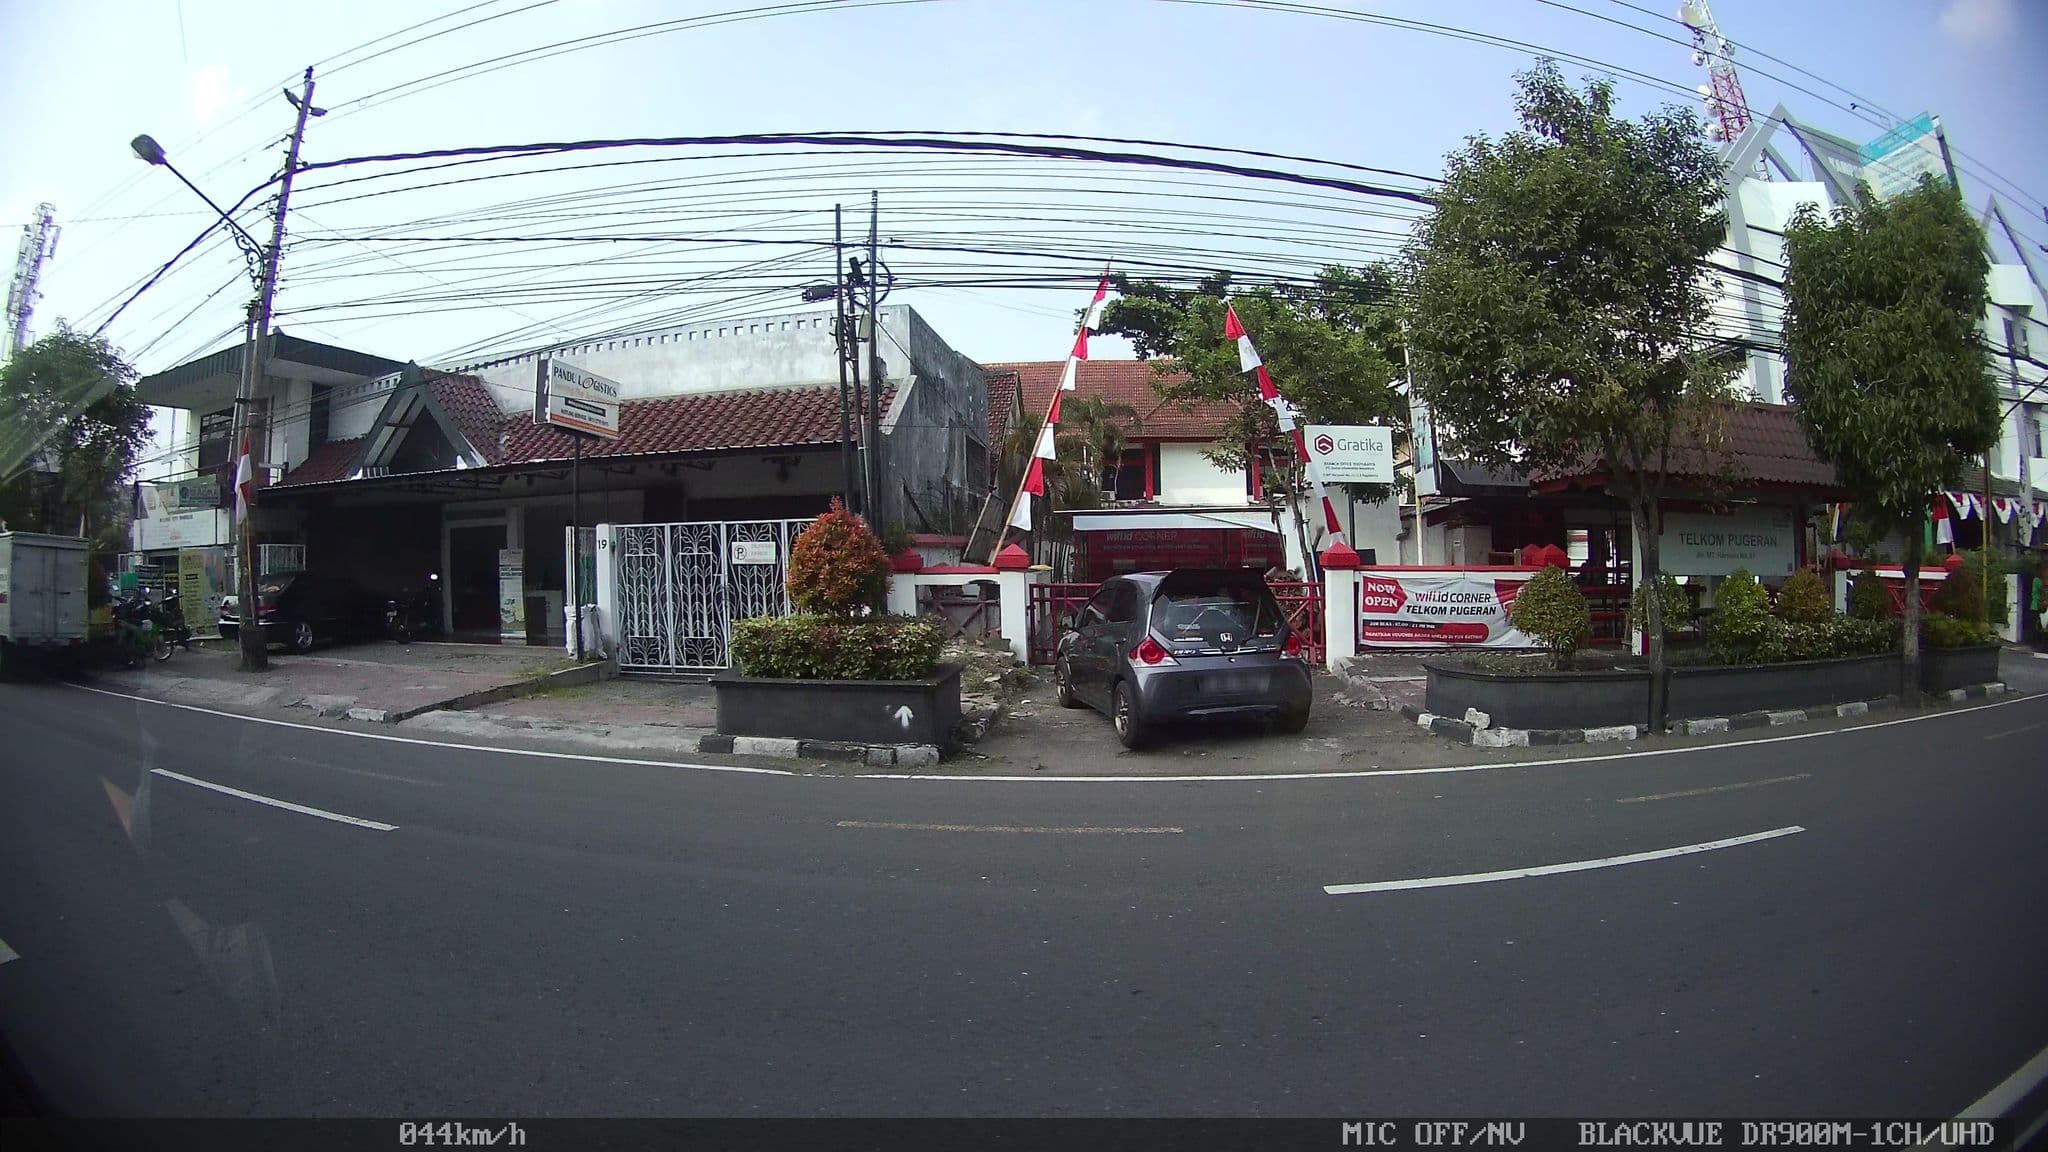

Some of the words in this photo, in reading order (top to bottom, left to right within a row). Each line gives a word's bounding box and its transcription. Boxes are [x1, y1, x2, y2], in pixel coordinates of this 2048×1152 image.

[554, 366, 576, 384] PANDU
[577, 375, 618, 398] LOGISTICS
[1338, 438, 1384, 452] Gratika
[598, 539, 608, 550] 19
[1679, 532, 1725, 547] TELKOM
[1727, 533, 1777, 548] PUGERAN
[1367, 582, 1397, 595] NOW
[1365, 595, 1398, 608] OPEN
[1415, 590, 1449, 603] wifi.id
[1449, 592, 1492, 603] CORNER
[1406, 604, 1448, 616] TELKOM
[1449, 605, 1497, 616] PUGERAN
